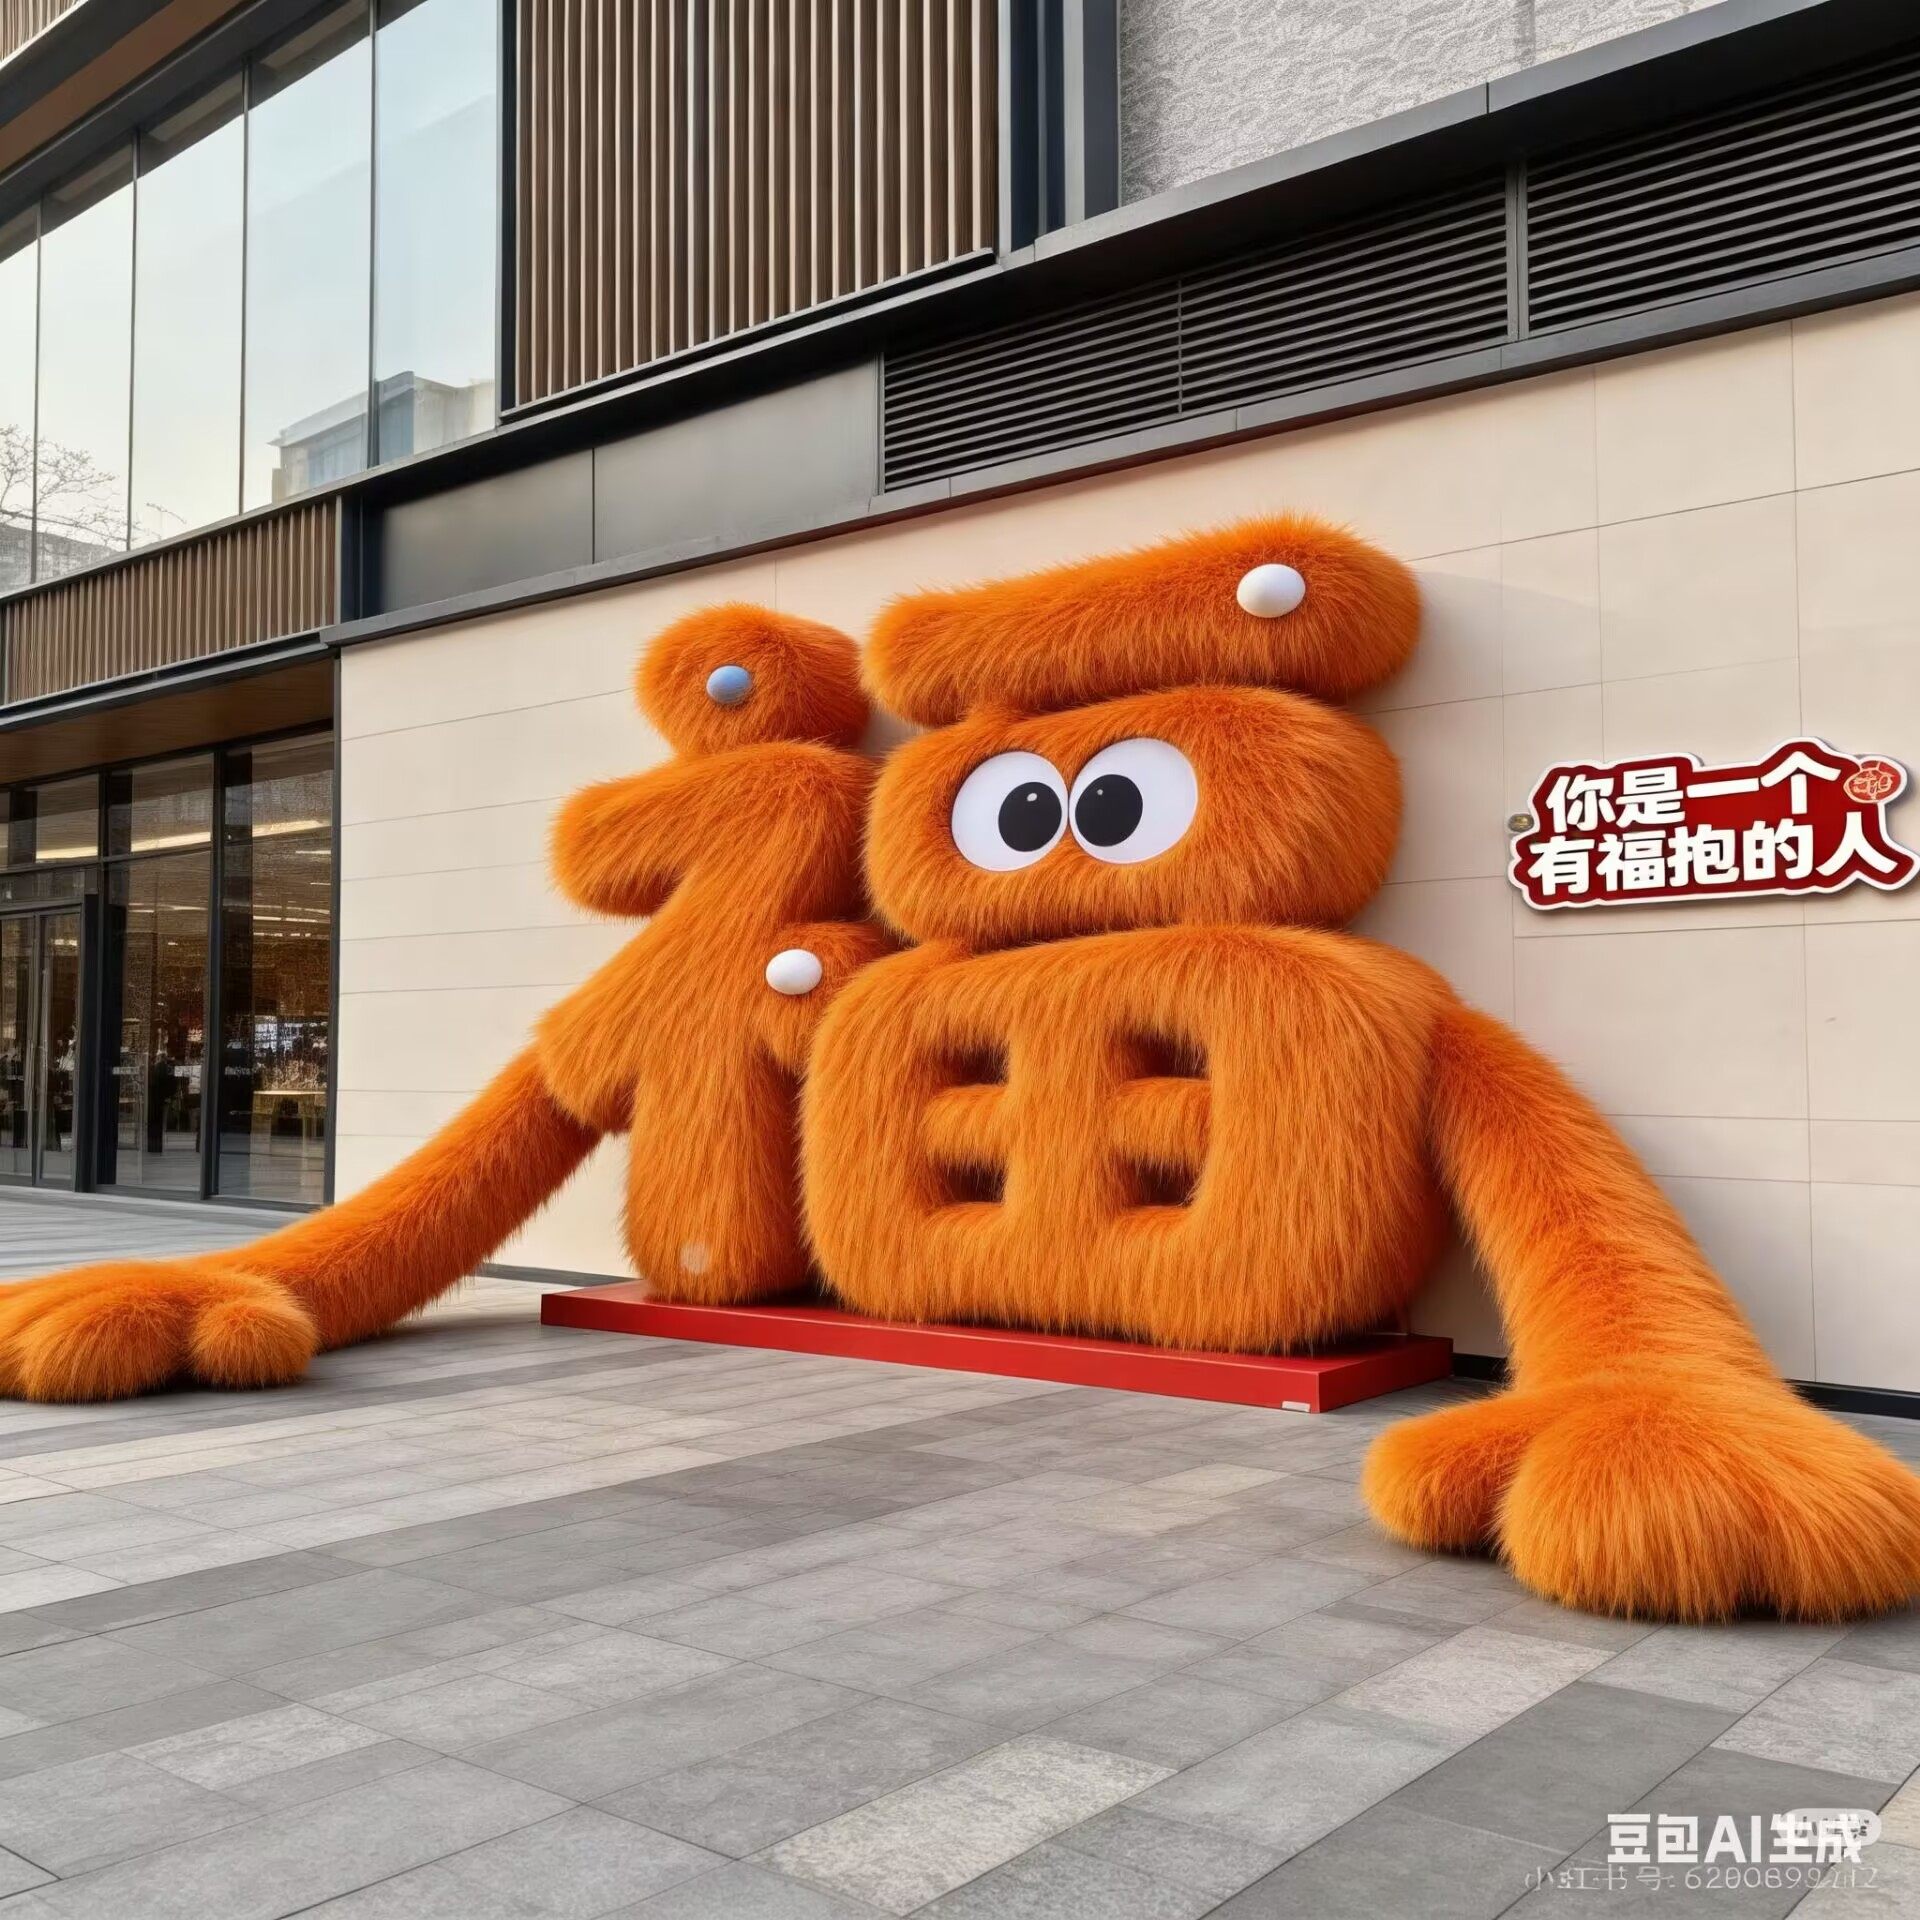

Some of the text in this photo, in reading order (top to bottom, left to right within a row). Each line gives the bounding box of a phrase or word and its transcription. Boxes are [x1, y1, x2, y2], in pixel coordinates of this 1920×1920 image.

[1545, 751, 1841, 833] 你是一个
[1527, 811, 1898, 896] 有福抱的人
